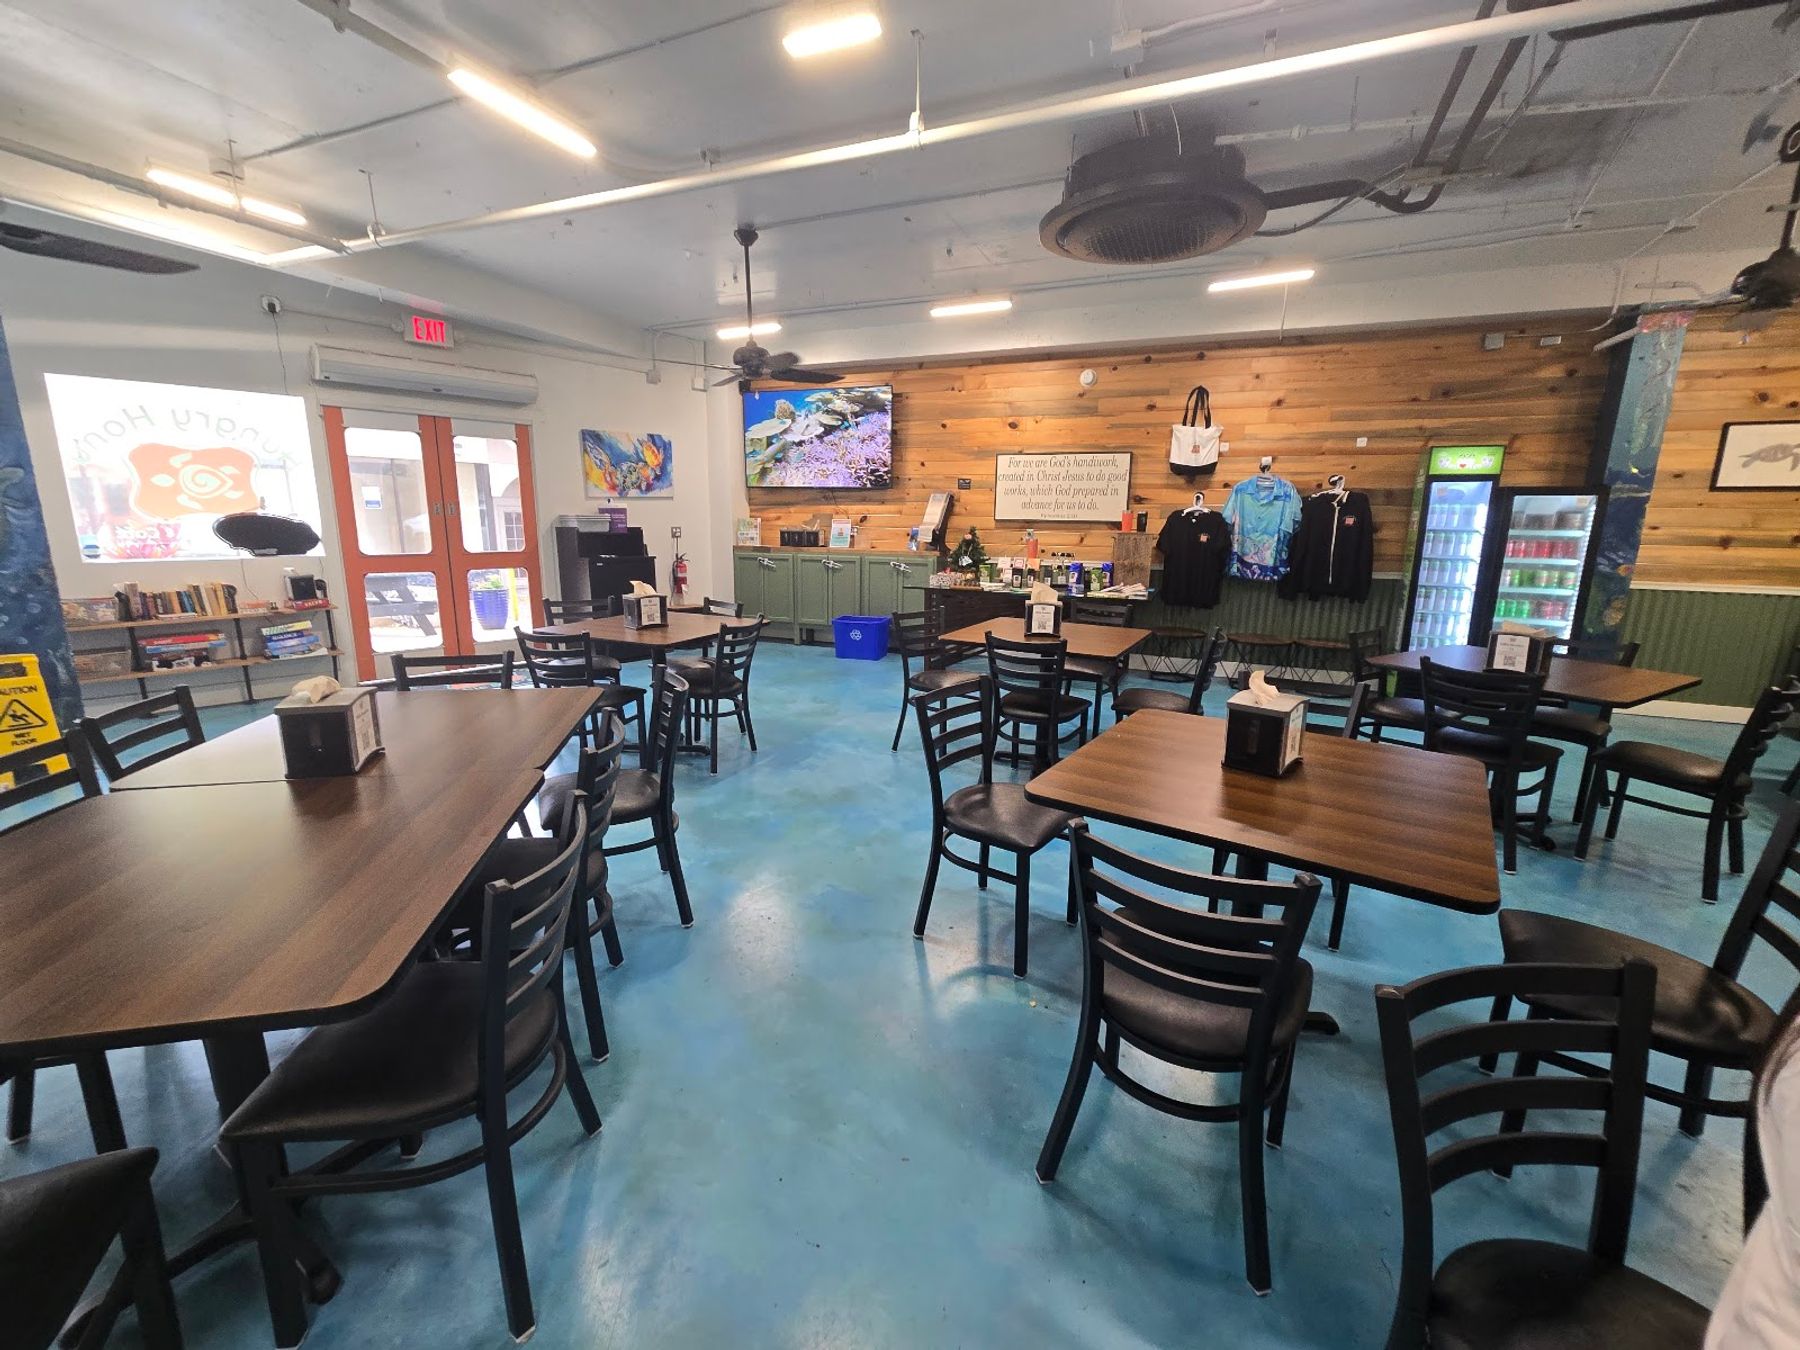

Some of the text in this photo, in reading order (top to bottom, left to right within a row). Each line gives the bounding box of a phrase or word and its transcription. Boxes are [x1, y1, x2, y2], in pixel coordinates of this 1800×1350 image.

[412, 316, 445, 343] EXIT
[1008, 454, 1119, 468] For we are God's handiwork,
[998, 469, 1128, 483] created in Christ Jesus to do good
[1003, 483, 1119, 498] works, which God prepared in
[1021, 498, 1100, 512] advance for us to do.
